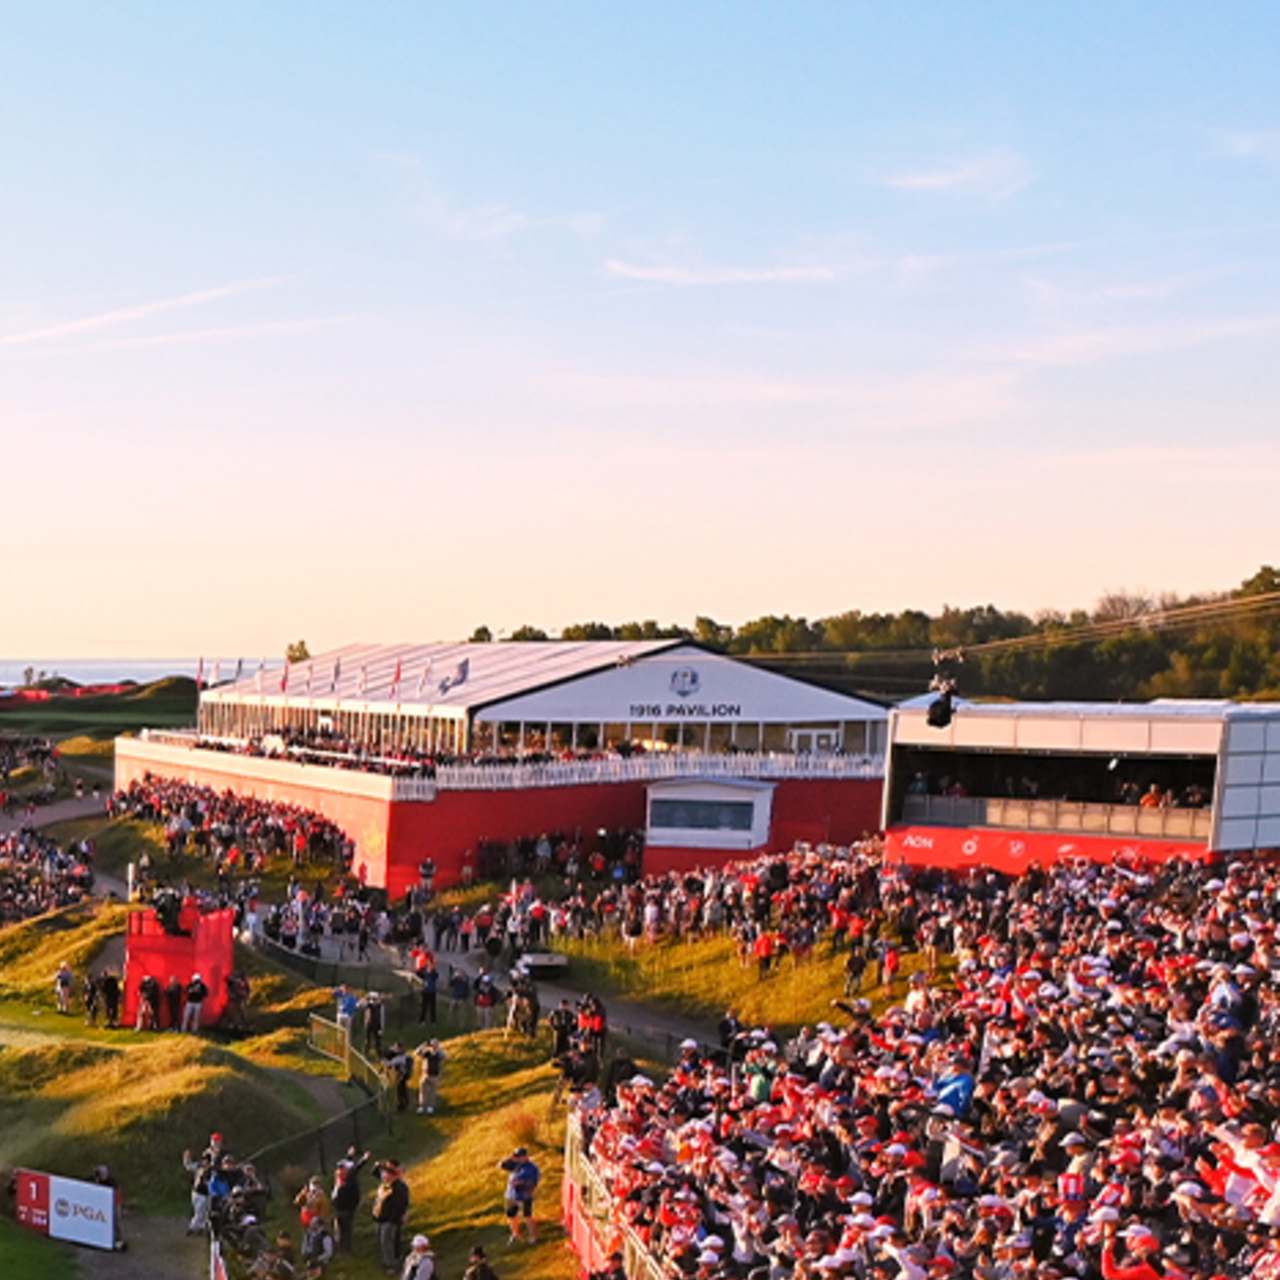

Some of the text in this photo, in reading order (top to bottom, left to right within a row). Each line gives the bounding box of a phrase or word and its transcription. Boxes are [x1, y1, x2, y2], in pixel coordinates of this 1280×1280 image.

[629, 703, 741, 717] 1916 PAVILION
[902, 834, 934, 849] AON
[29, 1181, 37, 1200] 1
[72, 1203, 108, 1224] PGA
